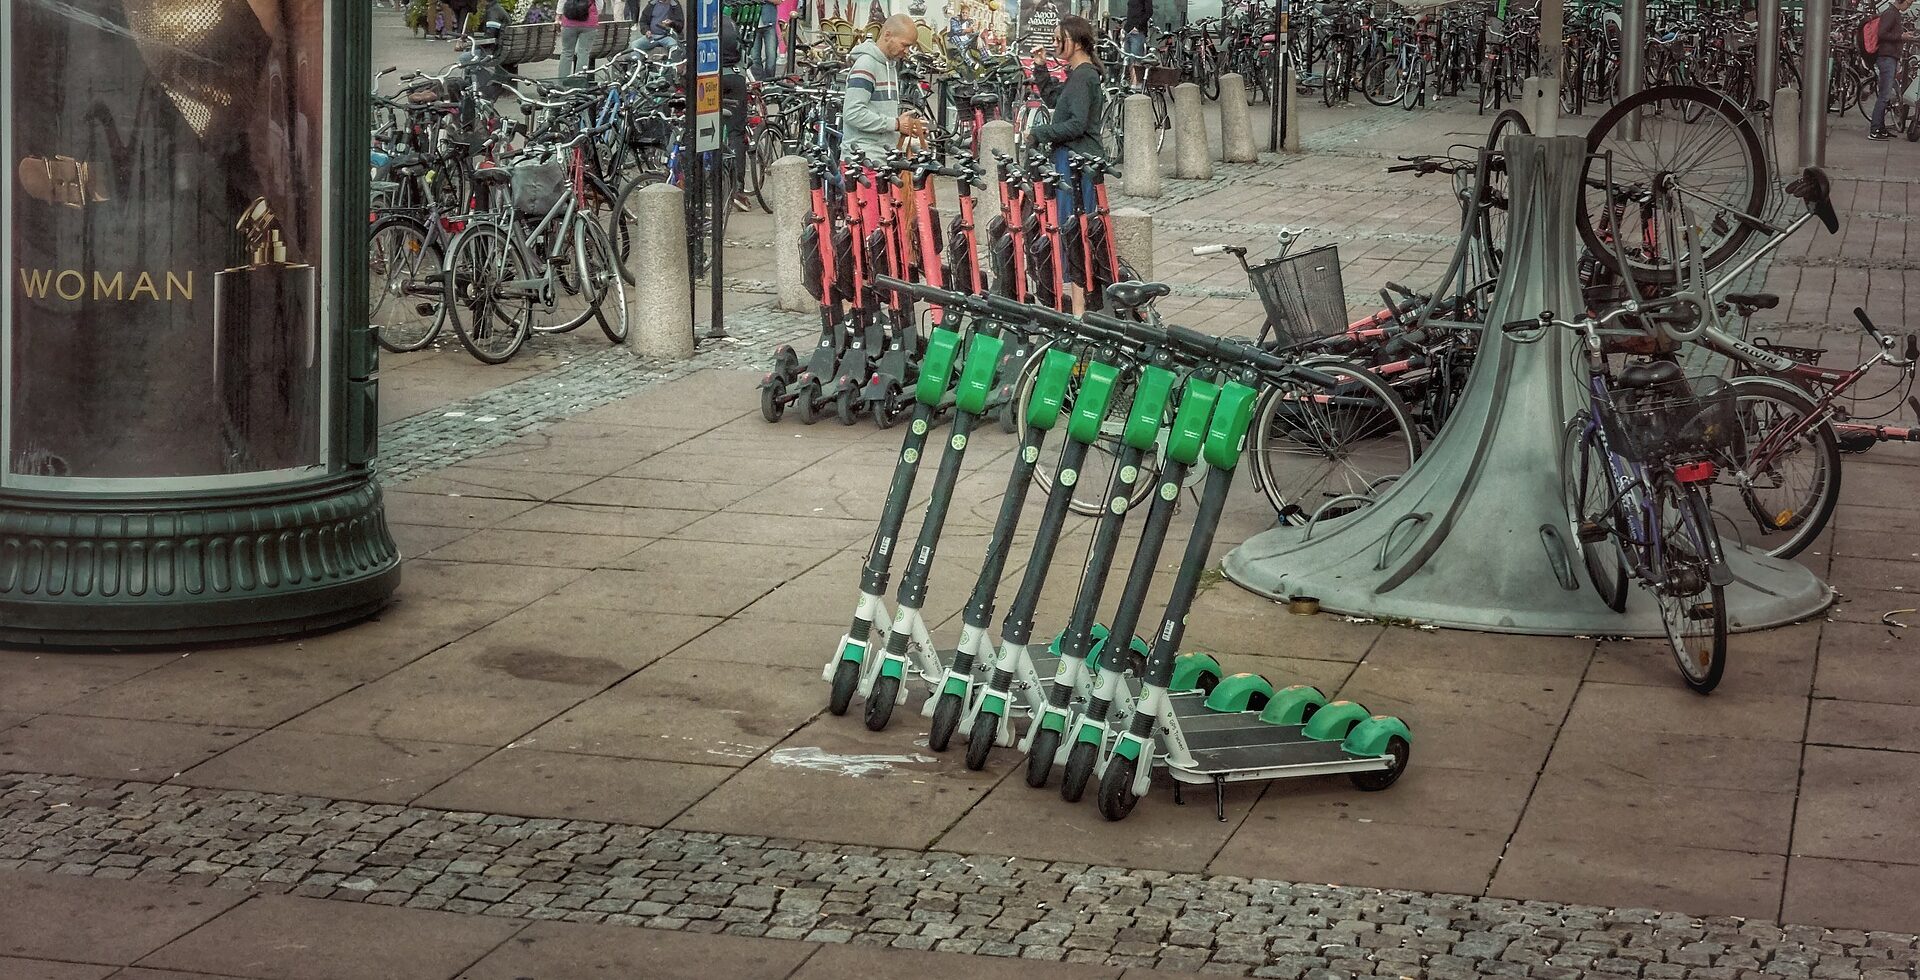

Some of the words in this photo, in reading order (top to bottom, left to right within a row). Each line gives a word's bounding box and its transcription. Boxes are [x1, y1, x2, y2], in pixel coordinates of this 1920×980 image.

[700, 50, 706, 63] 10
[707, 48, 717, 62] min
[20, 268, 193, 301] WOMAN
[1733, 342, 1778, 364] CALVIN
